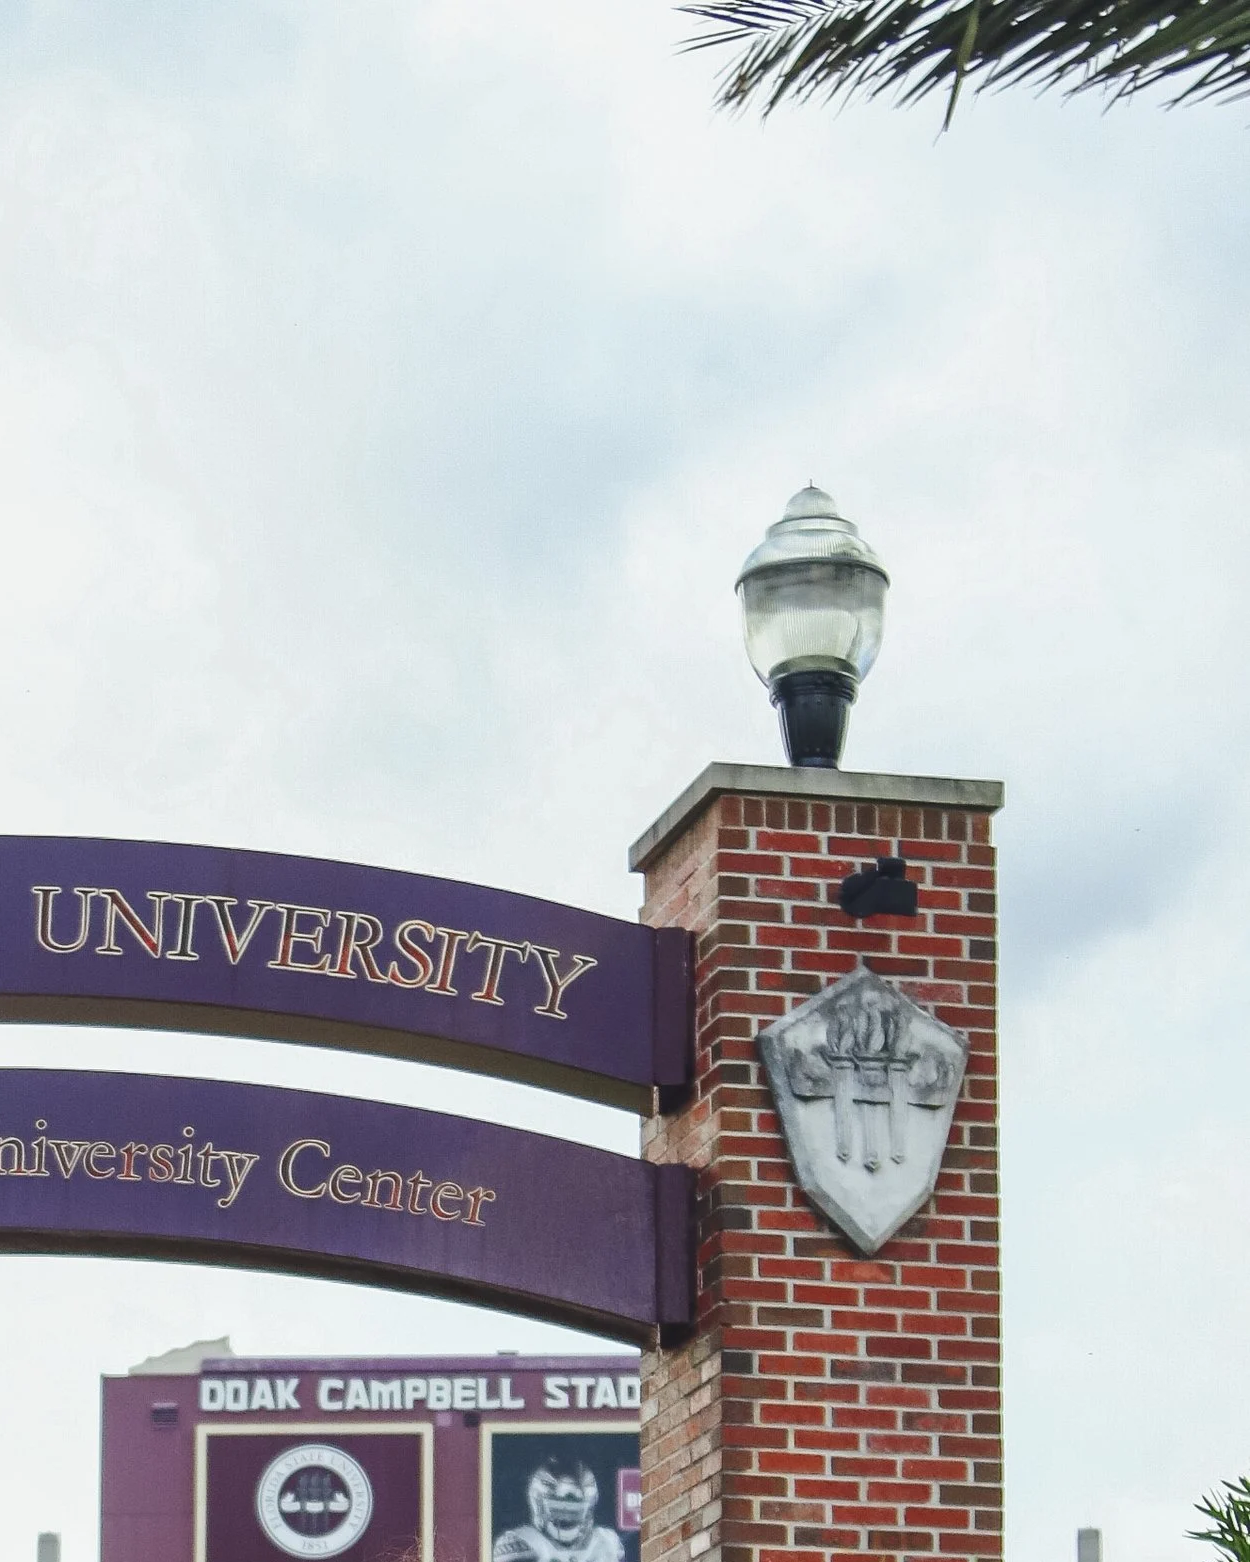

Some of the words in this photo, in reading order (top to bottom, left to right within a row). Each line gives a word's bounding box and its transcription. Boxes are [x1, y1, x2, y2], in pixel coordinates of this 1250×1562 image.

[32, 886, 598, 1020] UNIVERSITY
[277, 1139, 496, 1226] Center
[201, 1378, 301, 1411] DOAK
[319, 1377, 525, 1411] CAMPBELL
[545, 1376, 640, 1408] STAD
